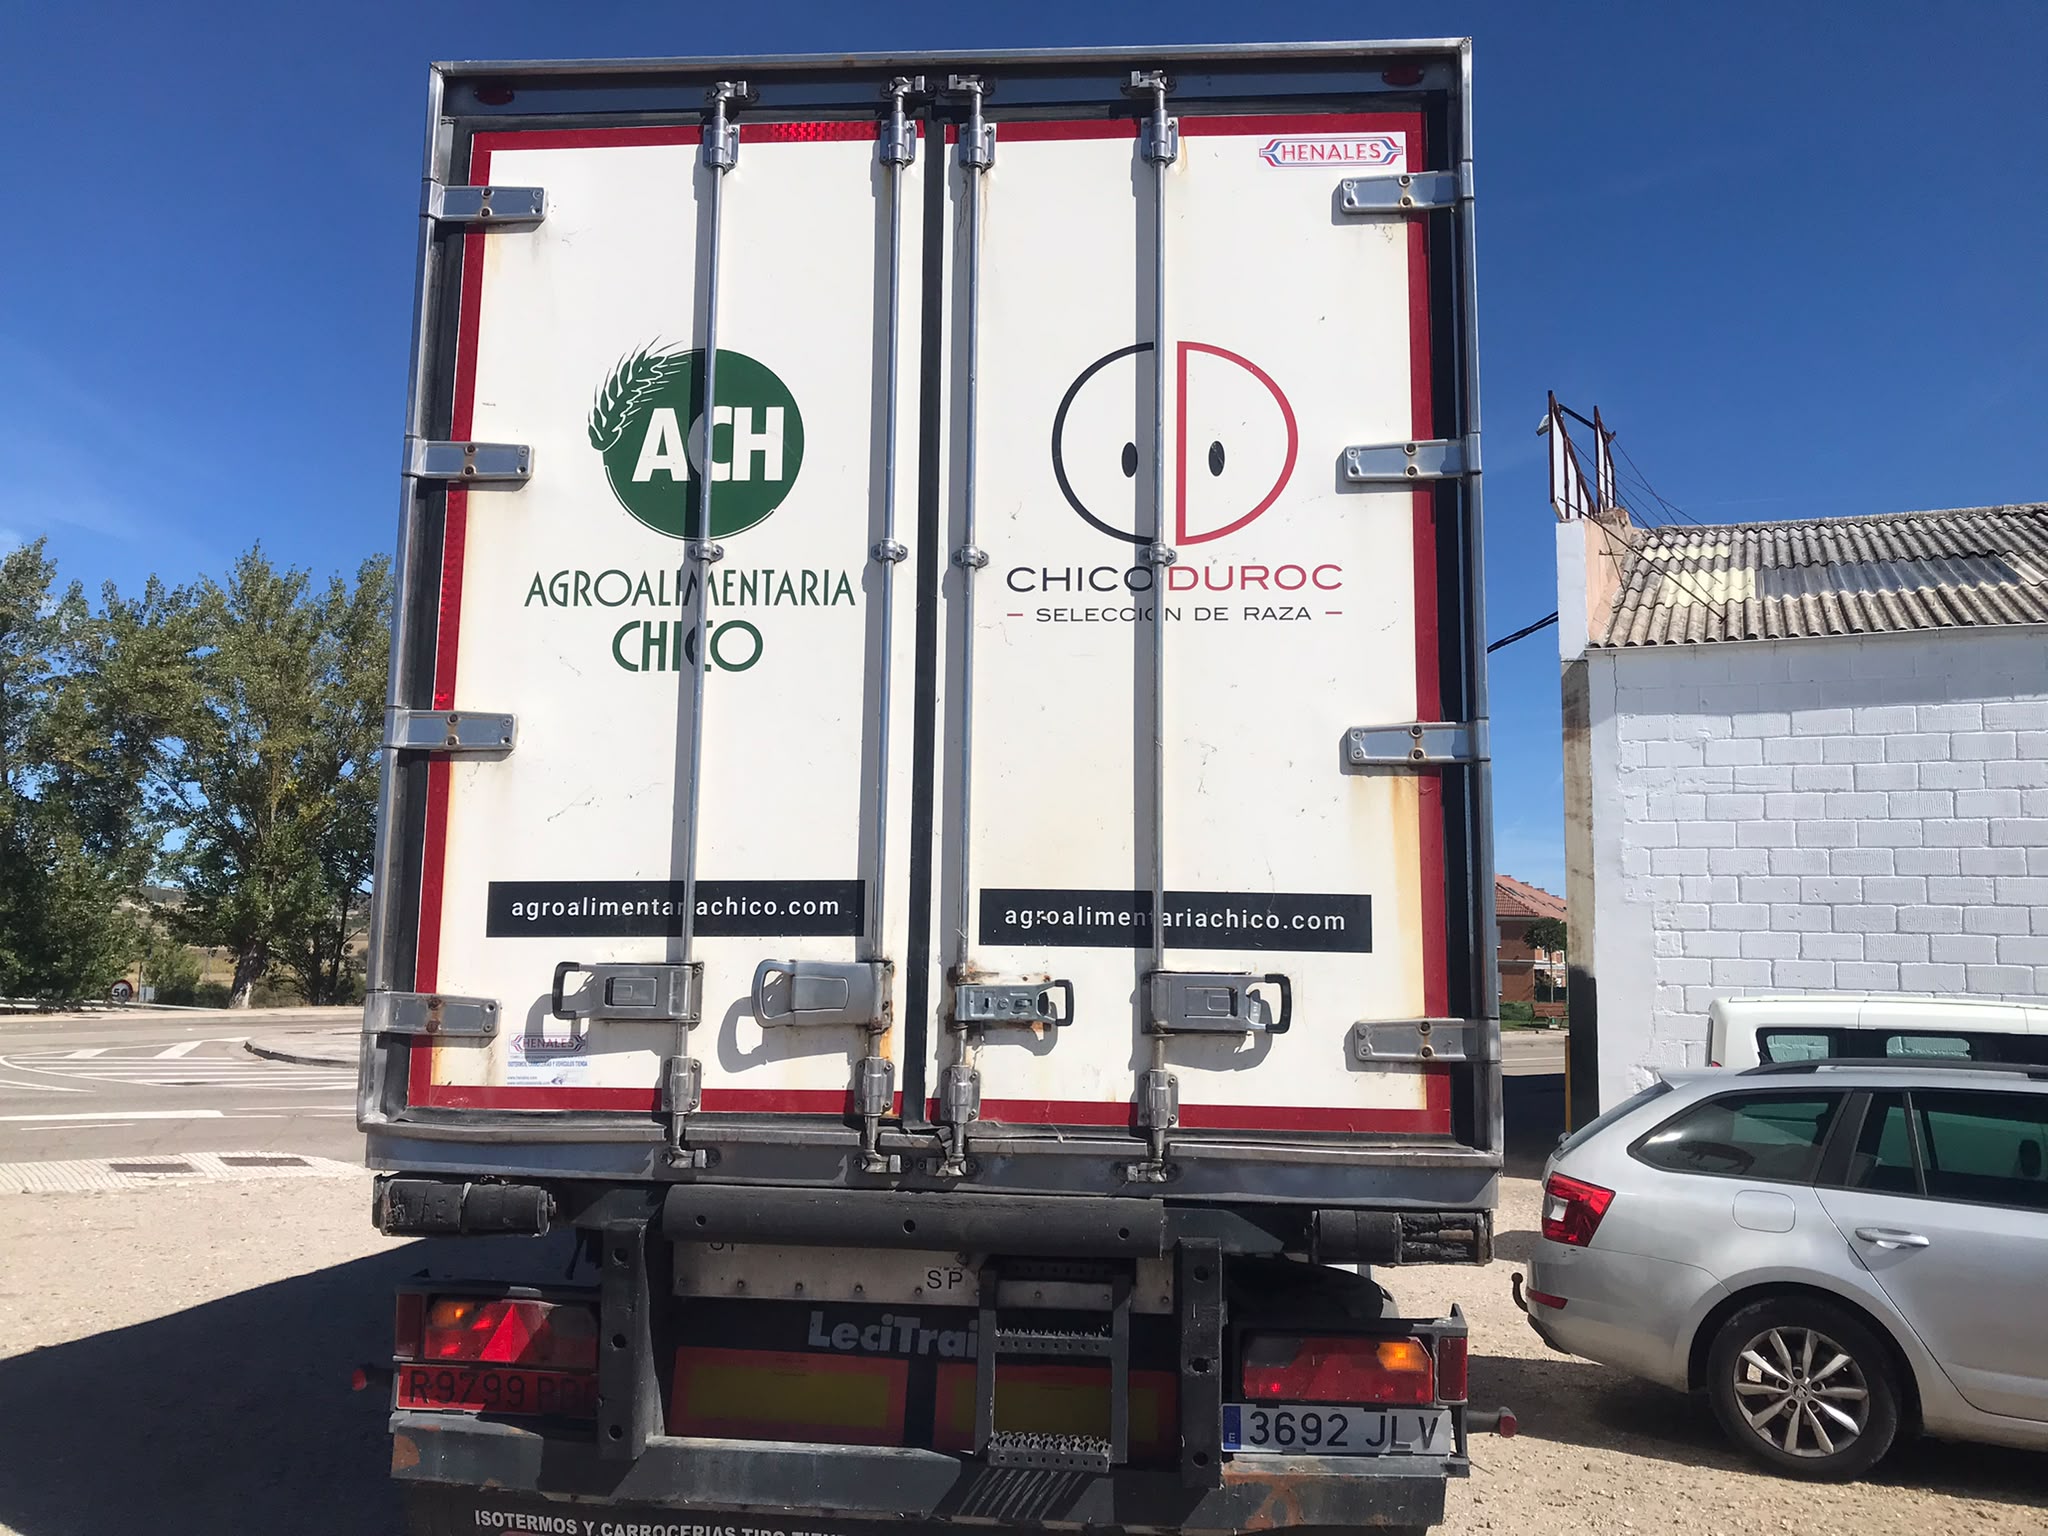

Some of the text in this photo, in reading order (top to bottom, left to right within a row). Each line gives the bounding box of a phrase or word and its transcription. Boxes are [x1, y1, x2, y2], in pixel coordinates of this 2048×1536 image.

[1281, 143, 1381, 161] HENALES
[631, 405, 785, 482] ACH
[524, 569, 856, 607] AGROALIMENTARIA
[1006, 564, 1344, 593] CHICO DUROC
[1194, 607, 1229, 621] DE
[1243, 606, 1312, 621] RAZA
[611, 619, 764, 673] CHICO
[511, 896, 840, 921] agroalimentarachico.com
[112, 988, 128, 998] 50
[523, 1038, 574, 1049] HENALES
[927, 1270, 963, 1289] SP
[808, 1310, 979, 1357] LeciTrai
[1249, 1410, 1439, 1450] 3692 JLV
[474, 1509, 578, 1535] ISOTERMOS
[582, 1520, 595, 1536] Y
